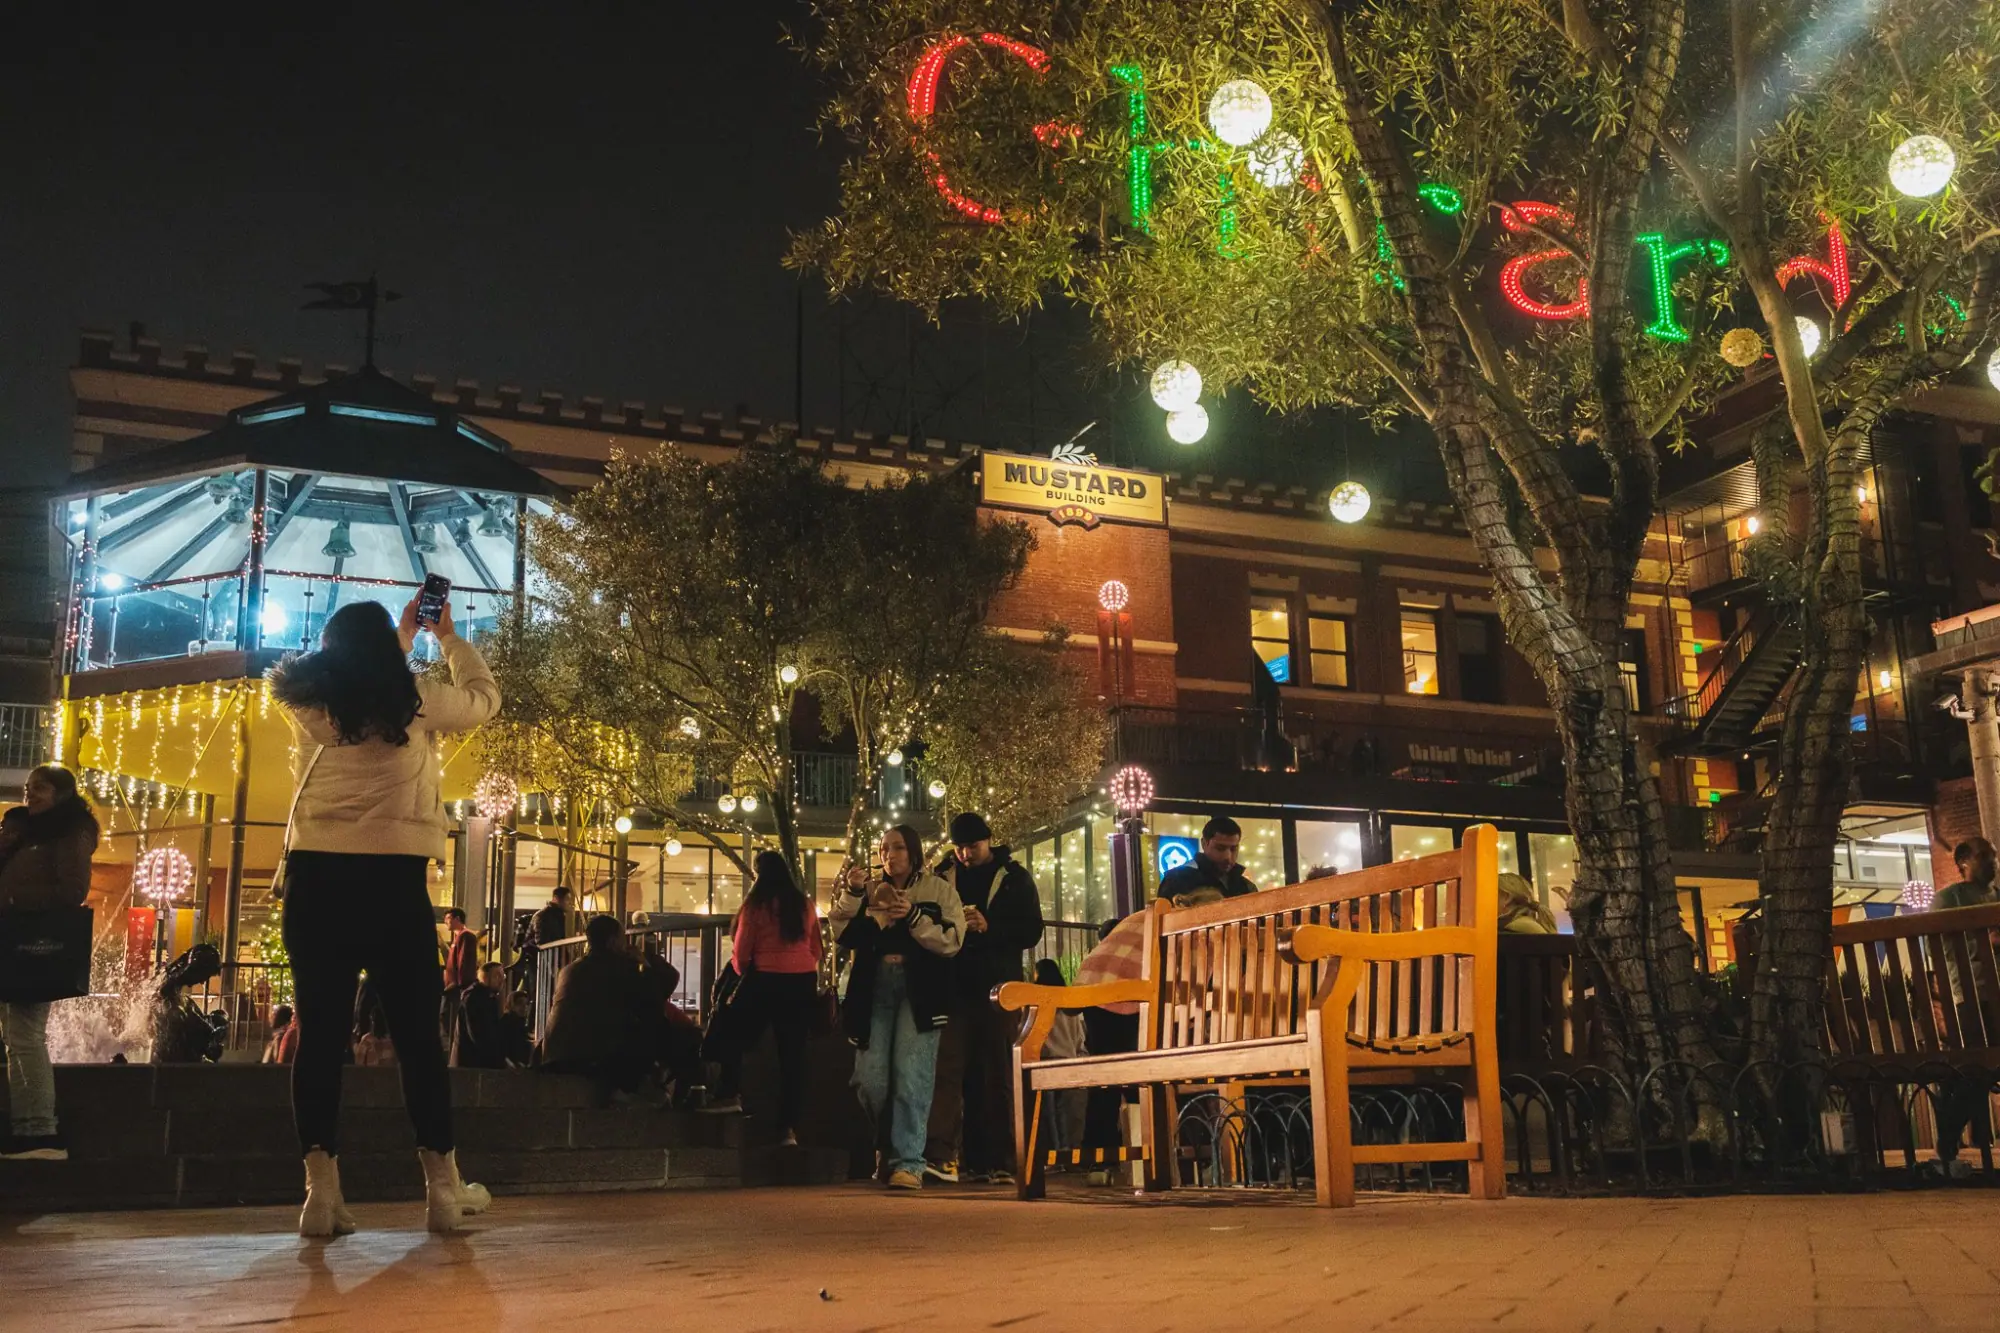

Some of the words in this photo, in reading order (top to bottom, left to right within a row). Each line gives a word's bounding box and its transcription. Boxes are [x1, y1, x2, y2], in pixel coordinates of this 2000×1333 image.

[1004, 462, 1147, 499] MUSTARD
[1046, 490, 1106, 506] BUILDING
[1147, 842, 1155, 882] PLAZA
